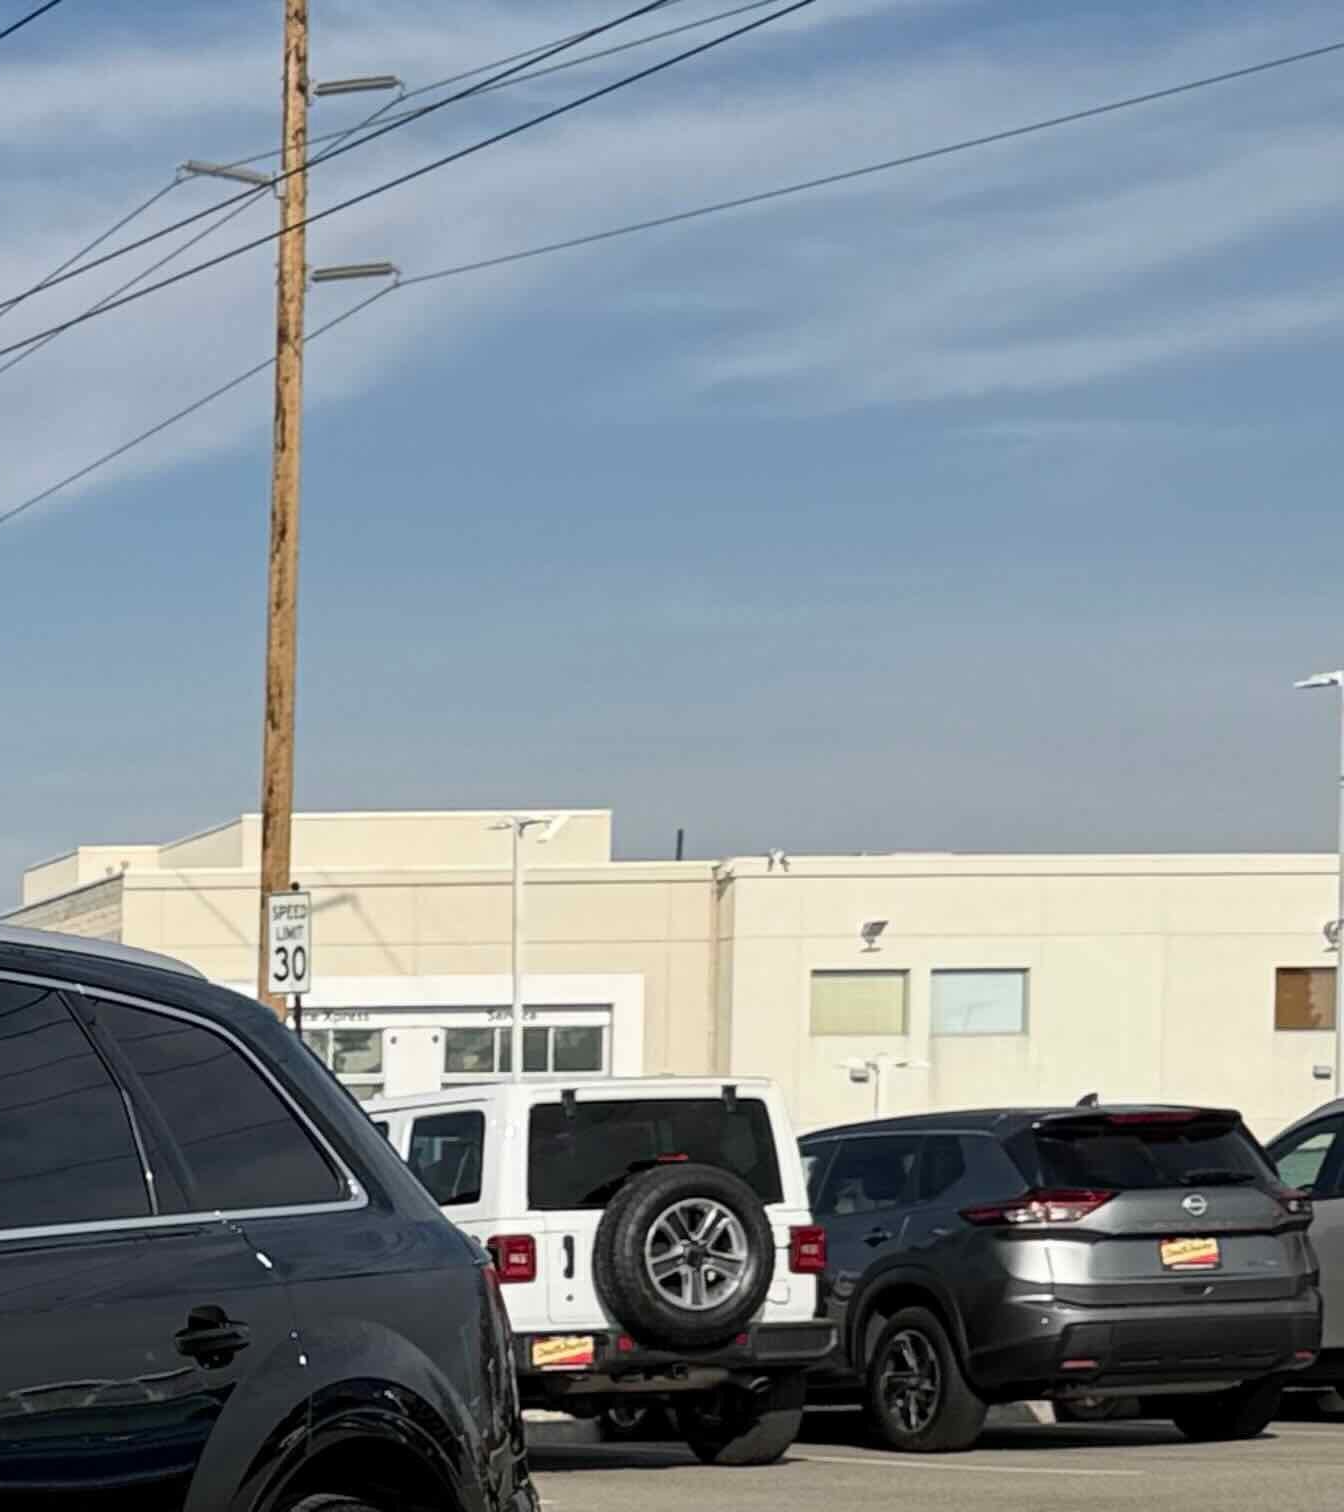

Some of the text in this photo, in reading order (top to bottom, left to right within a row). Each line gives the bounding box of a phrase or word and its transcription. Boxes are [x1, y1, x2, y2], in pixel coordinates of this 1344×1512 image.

[273, 904, 307, 921] SPEED
[275, 925, 304, 941] LIMIT
[273, 945, 306, 982] 30
[486, 1008, 537, 1022] Servce
